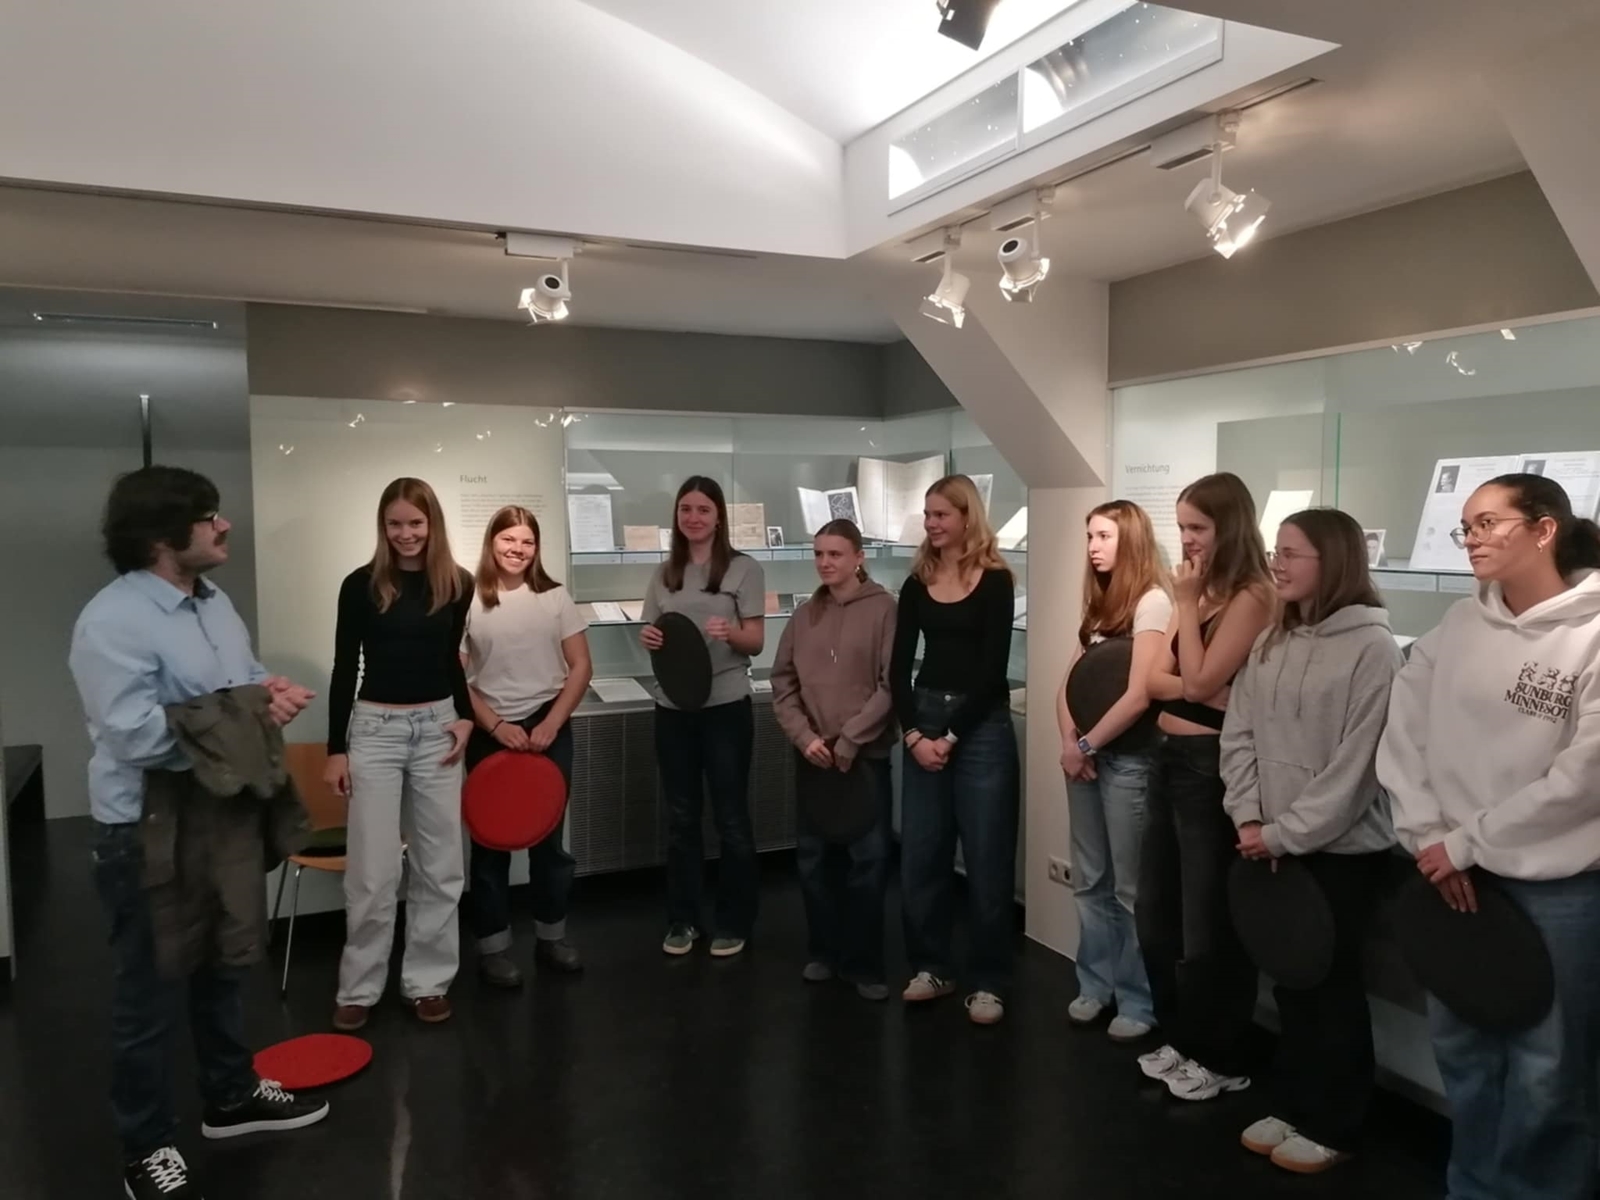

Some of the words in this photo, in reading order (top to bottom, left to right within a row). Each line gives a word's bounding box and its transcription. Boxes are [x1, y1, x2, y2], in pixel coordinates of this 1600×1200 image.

[1125, 464, 1170, 475] Vernichtung
[460, 475, 488, 484] Flucht
[1515, 682, 1573, 708] SUNBURG
[1504, 690, 1569, 720] MINNESOT
